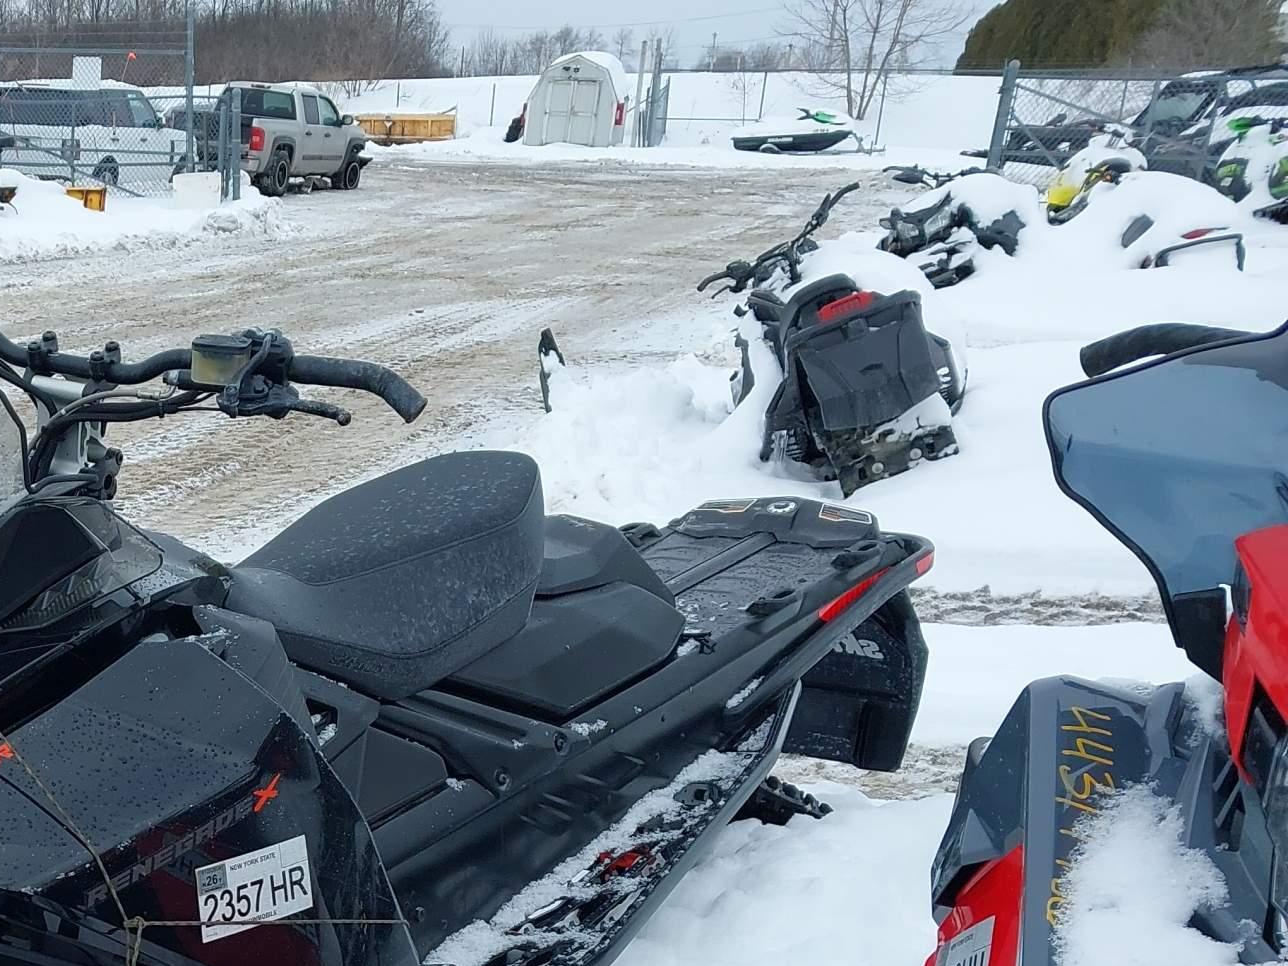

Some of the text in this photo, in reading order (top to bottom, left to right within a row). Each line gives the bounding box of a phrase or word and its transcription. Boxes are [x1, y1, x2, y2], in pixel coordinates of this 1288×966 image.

[85, 796, 255, 911] RENEGADE
[229, 862, 243, 872] NEW
[243, 857, 259, 869] YORK
[259, 851, 277, 863] STATE
